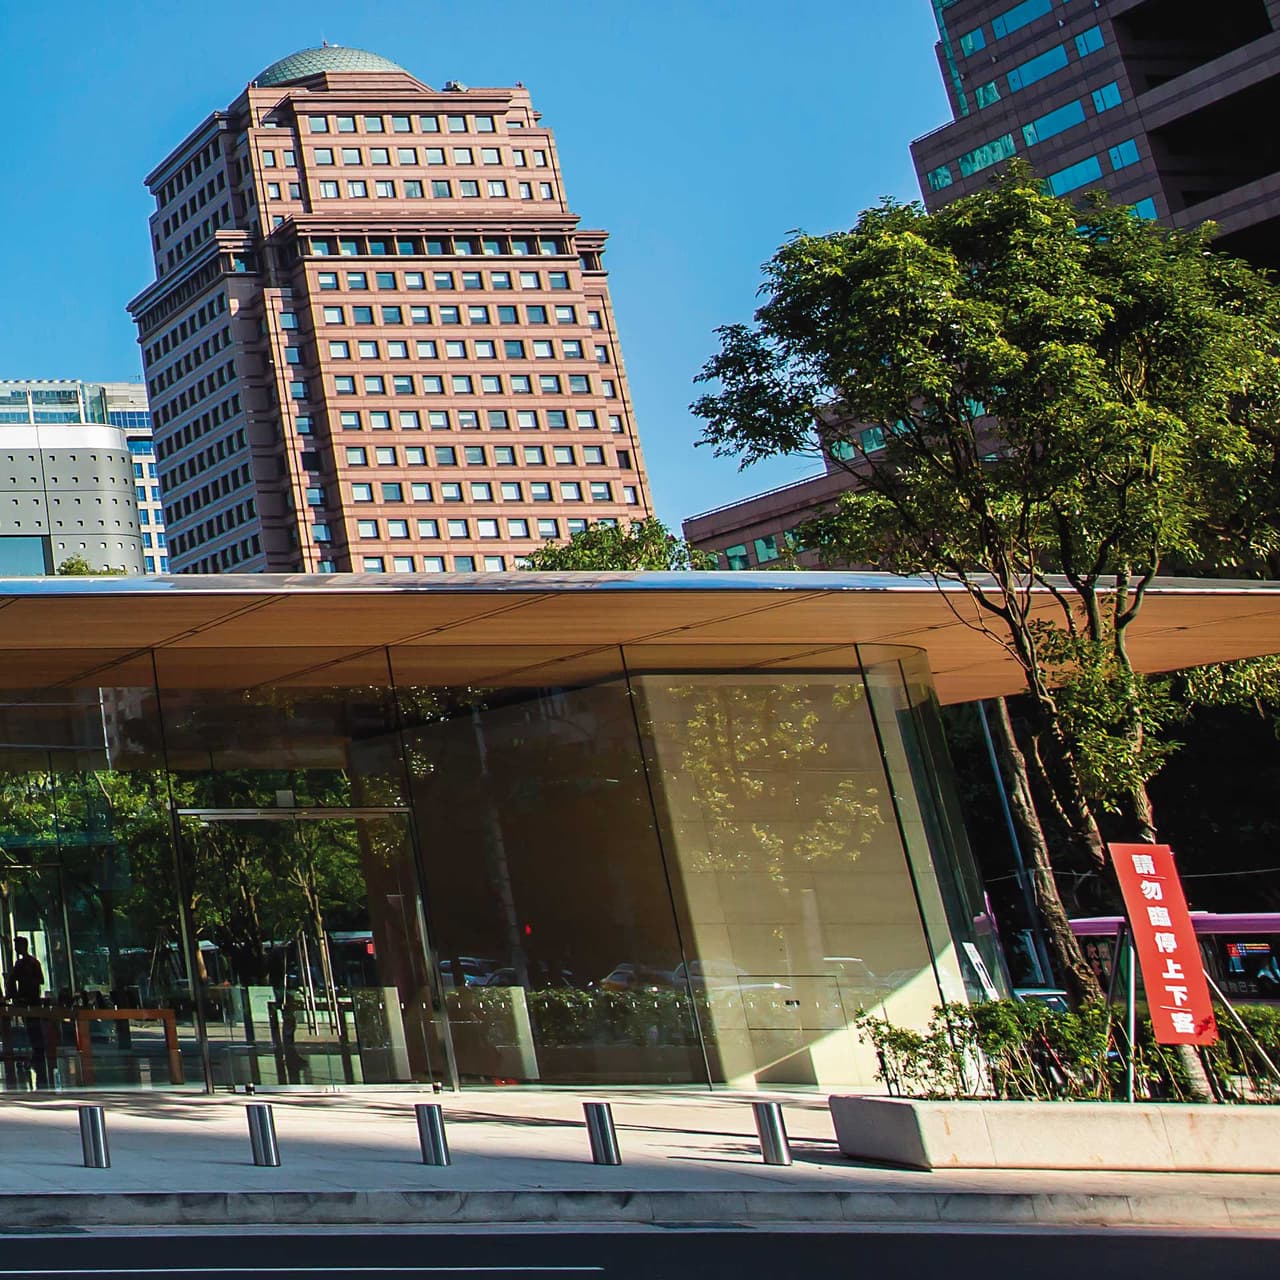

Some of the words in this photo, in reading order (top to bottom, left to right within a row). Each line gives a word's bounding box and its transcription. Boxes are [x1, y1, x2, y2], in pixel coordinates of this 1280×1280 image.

[1130, 854, 1196, 1034] 請勿臨停上下客
